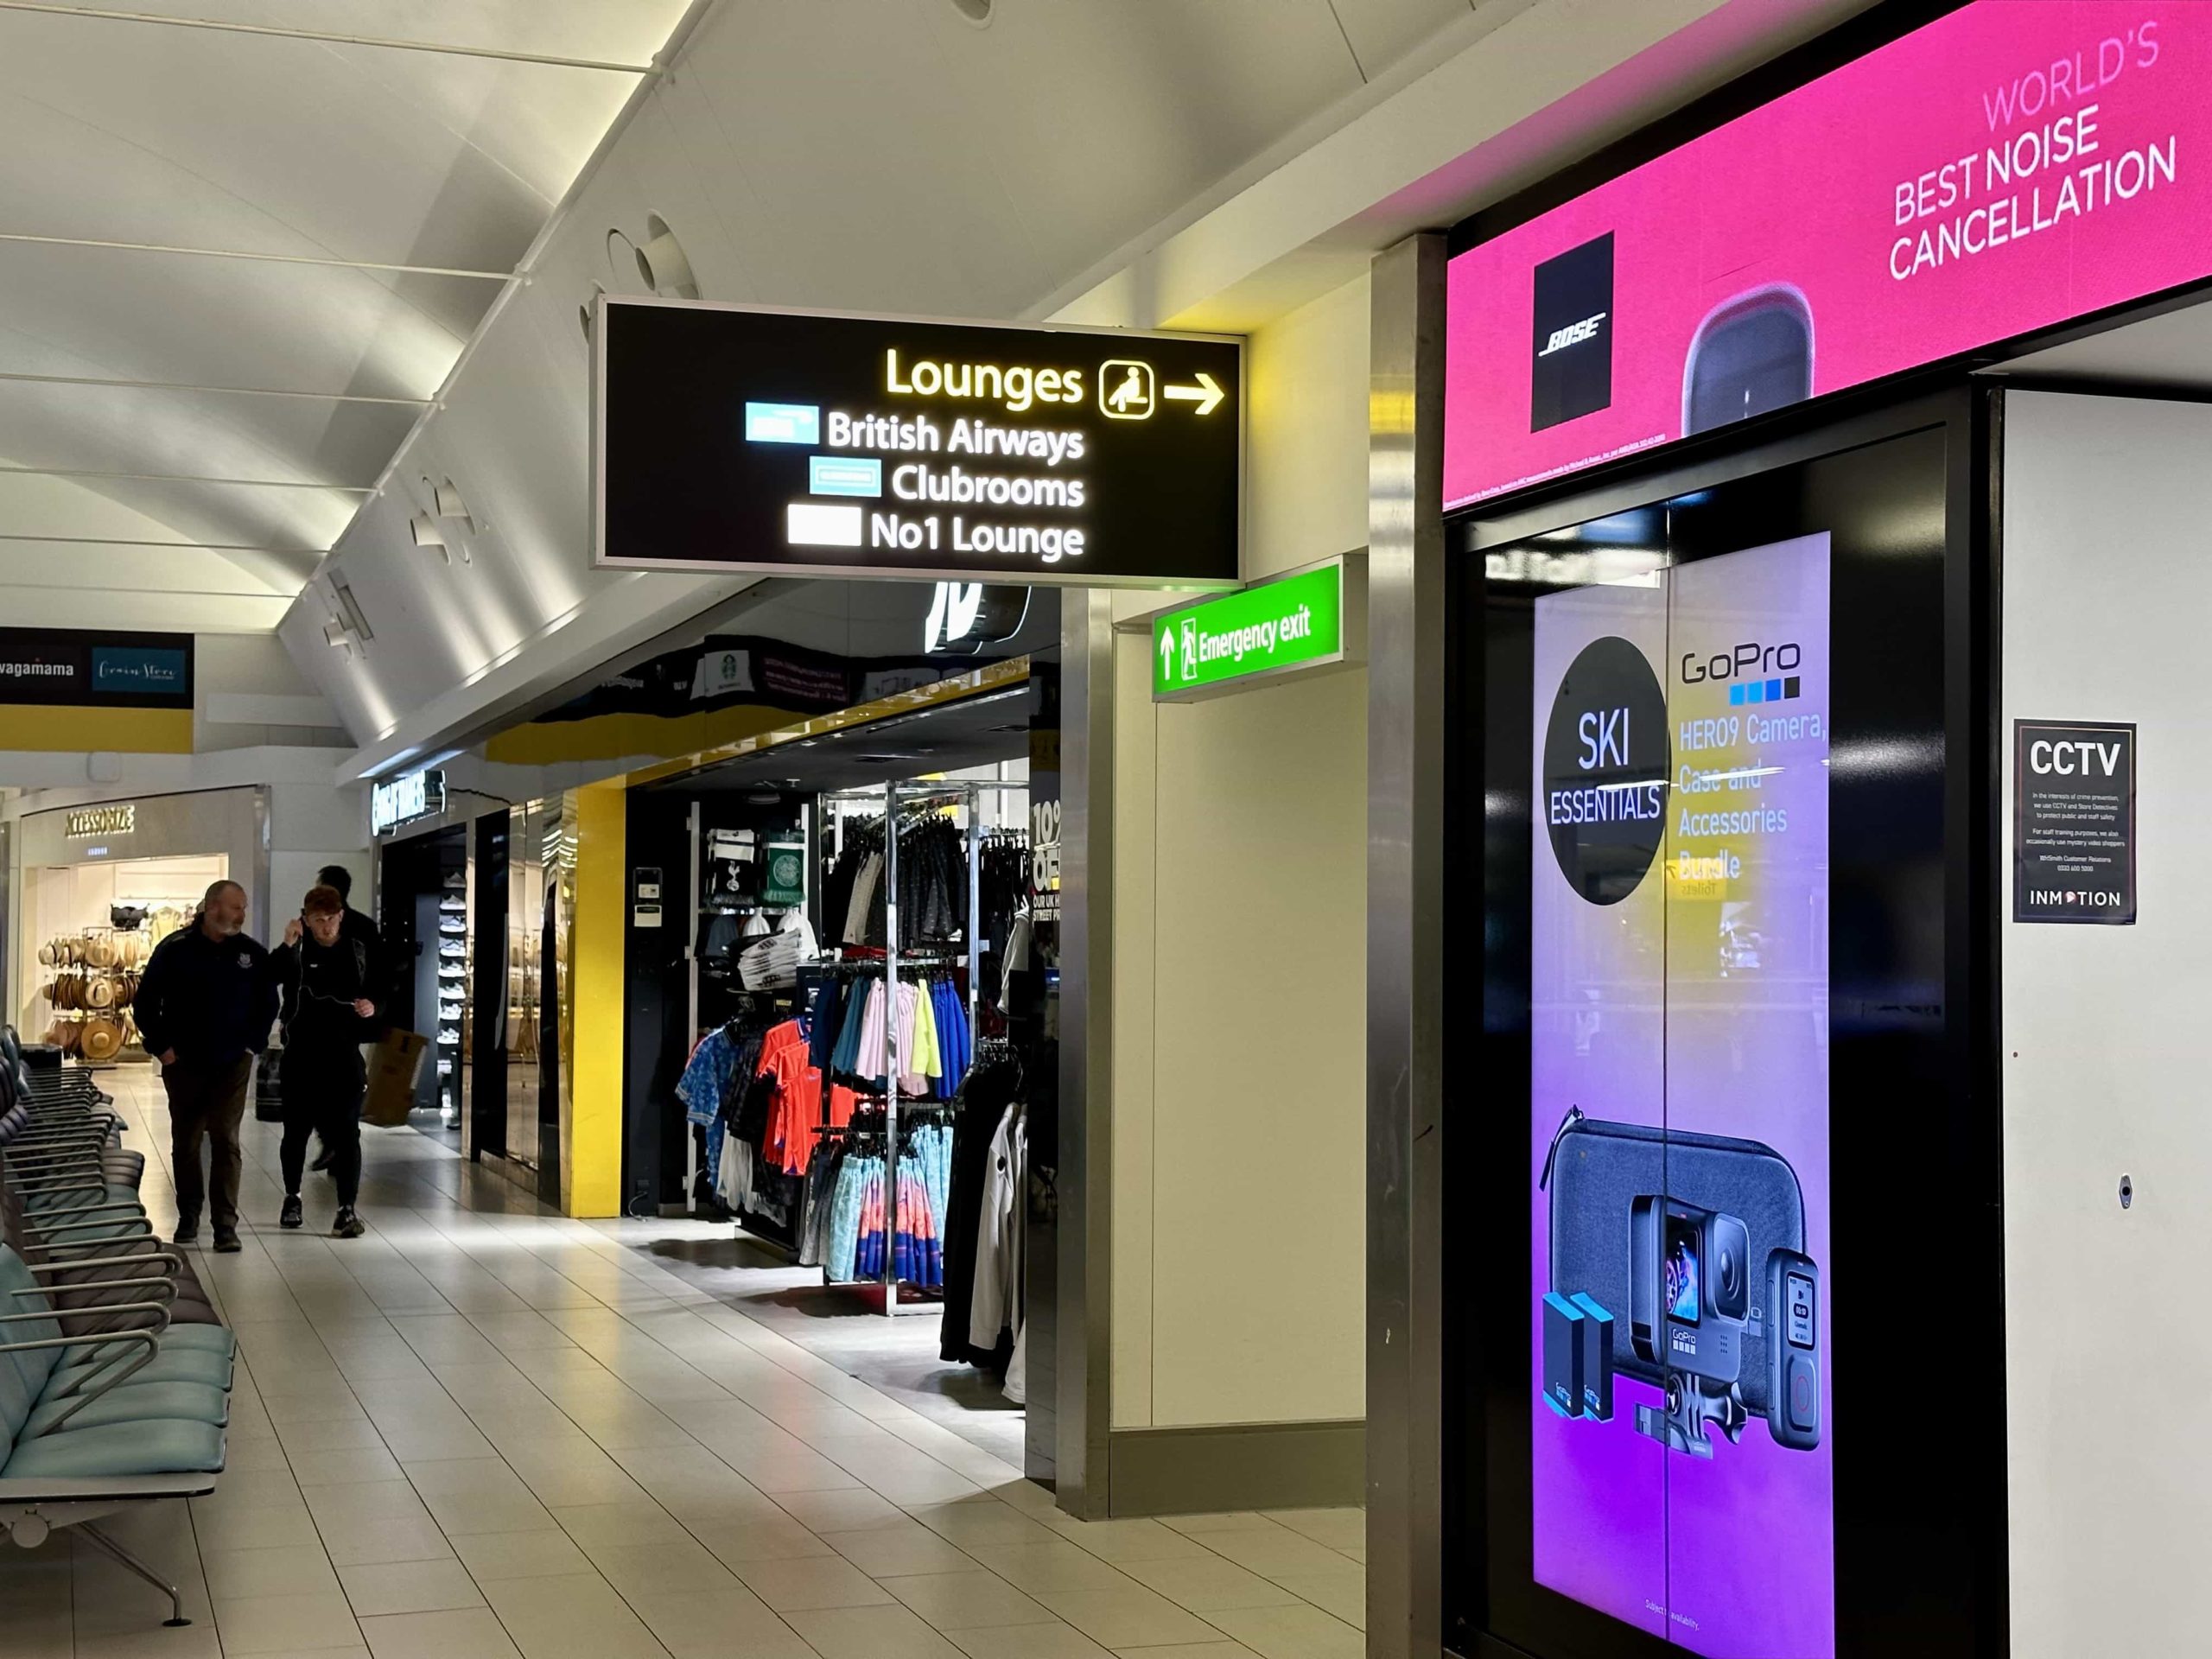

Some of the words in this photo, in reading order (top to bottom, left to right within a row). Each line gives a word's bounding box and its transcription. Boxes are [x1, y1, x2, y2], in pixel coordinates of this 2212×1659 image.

[1983, 21, 2158, 131] WORLD'S
[1896, 154, 1978, 226] BEST
[1986, 104, 2099, 191] NOISE
[1890, 135, 2175, 281] CANCELLATION
[1538, 312, 1606, 357] BOSE
[887, 348, 1084, 411] Lounges
[828, 412, 939, 452] British
[947, 418, 1084, 466] Airways
[892, 464, 1084, 507] Clubrooms
[871, 513, 938, 550] No1
[953, 517, 1084, 563] Lounge
[1198, 619, 1277, 662] Emergency
[1280, 604, 1311, 642] exit
[1681, 643, 1801, 683] GoPro
[1578, 708, 1630, 769] SKI
[1680, 716, 1739, 751] HERO9
[1747, 714, 1827, 746] Camera,
[1679, 764, 1720, 794] Case
[1730, 759, 1762, 791] and
[2031, 741, 2121, 776] CCTV
[1551, 785, 1660, 825] ESSENTIALS
[1679, 804, 1788, 836] Accessories
[1680, 848, 1740, 880] Bundle
[1672, 1328, 1696, 1344] GoPro
